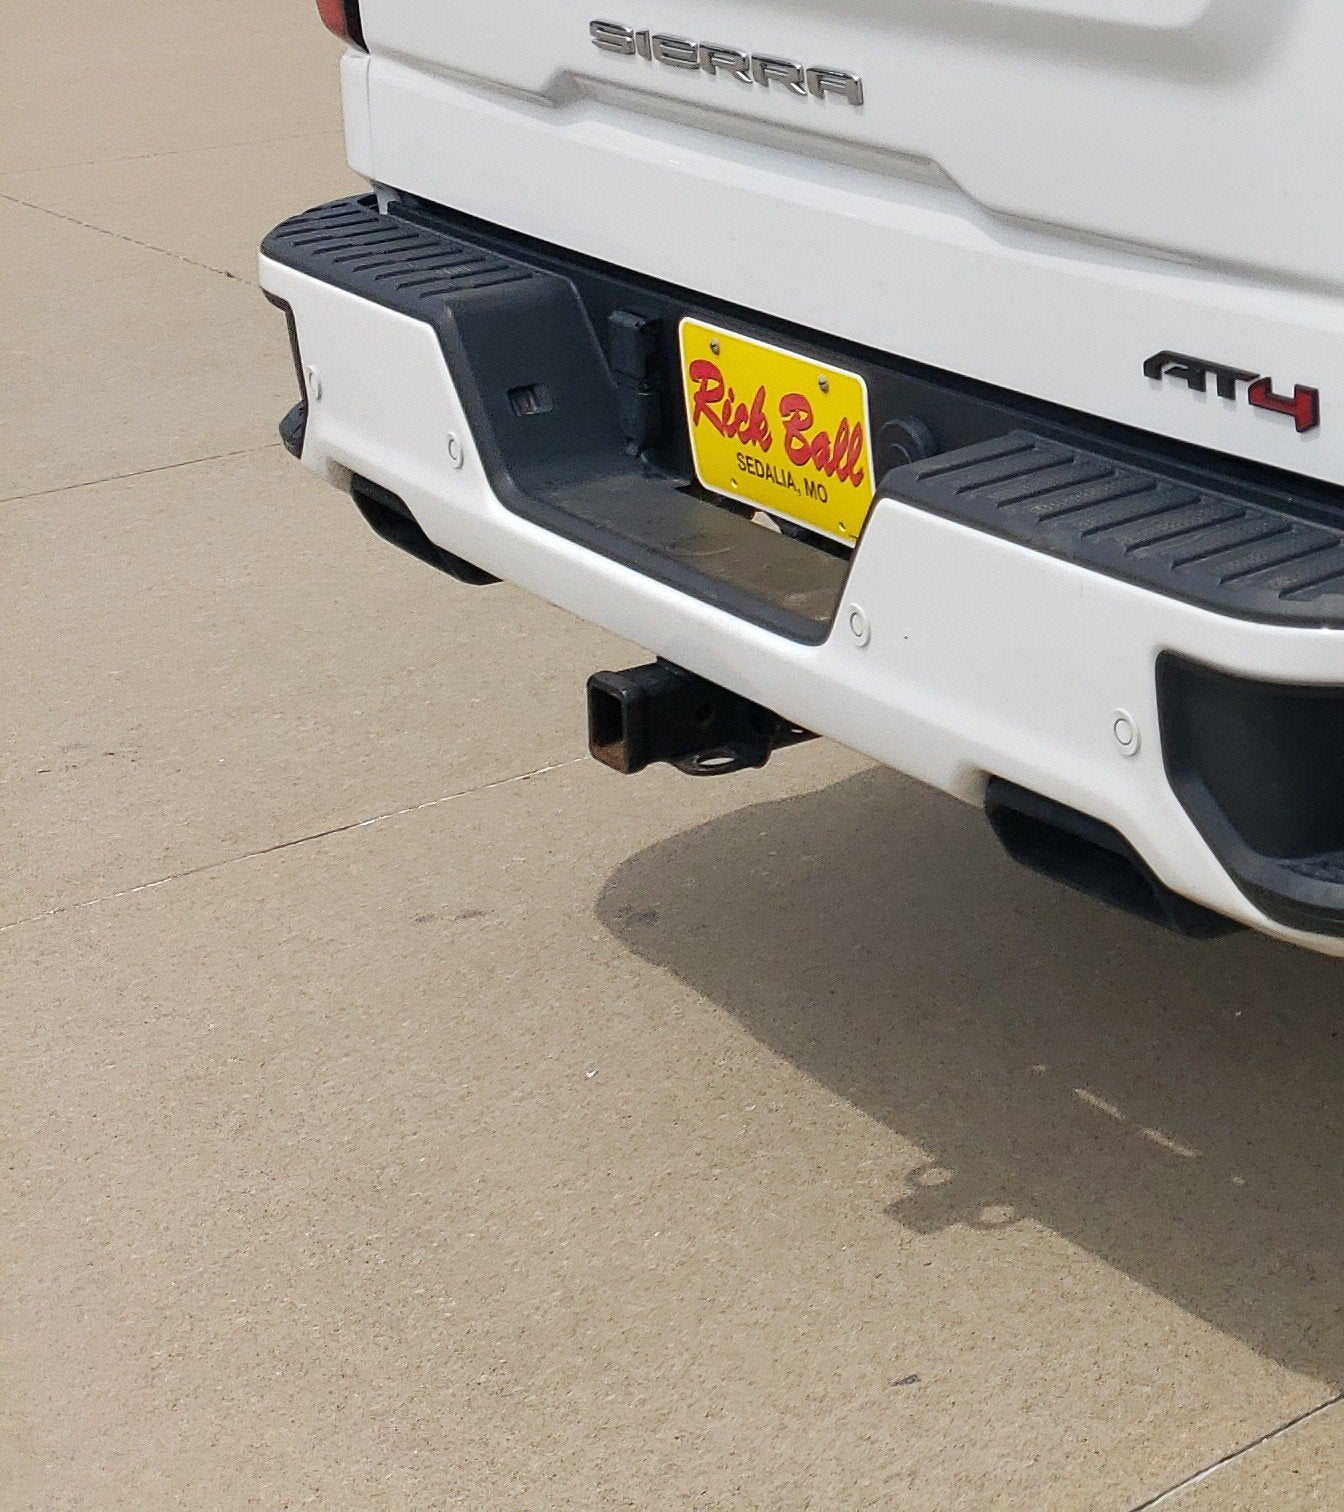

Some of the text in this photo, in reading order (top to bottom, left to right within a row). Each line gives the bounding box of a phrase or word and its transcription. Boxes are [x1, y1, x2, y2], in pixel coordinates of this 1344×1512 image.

[589, 18, 865, 106] SIERRA
[689, 359, 864, 487] Rick Ball
[1143, 350, 1321, 432] AT4
[736, 452, 828, 504] SEDALIA, MO
